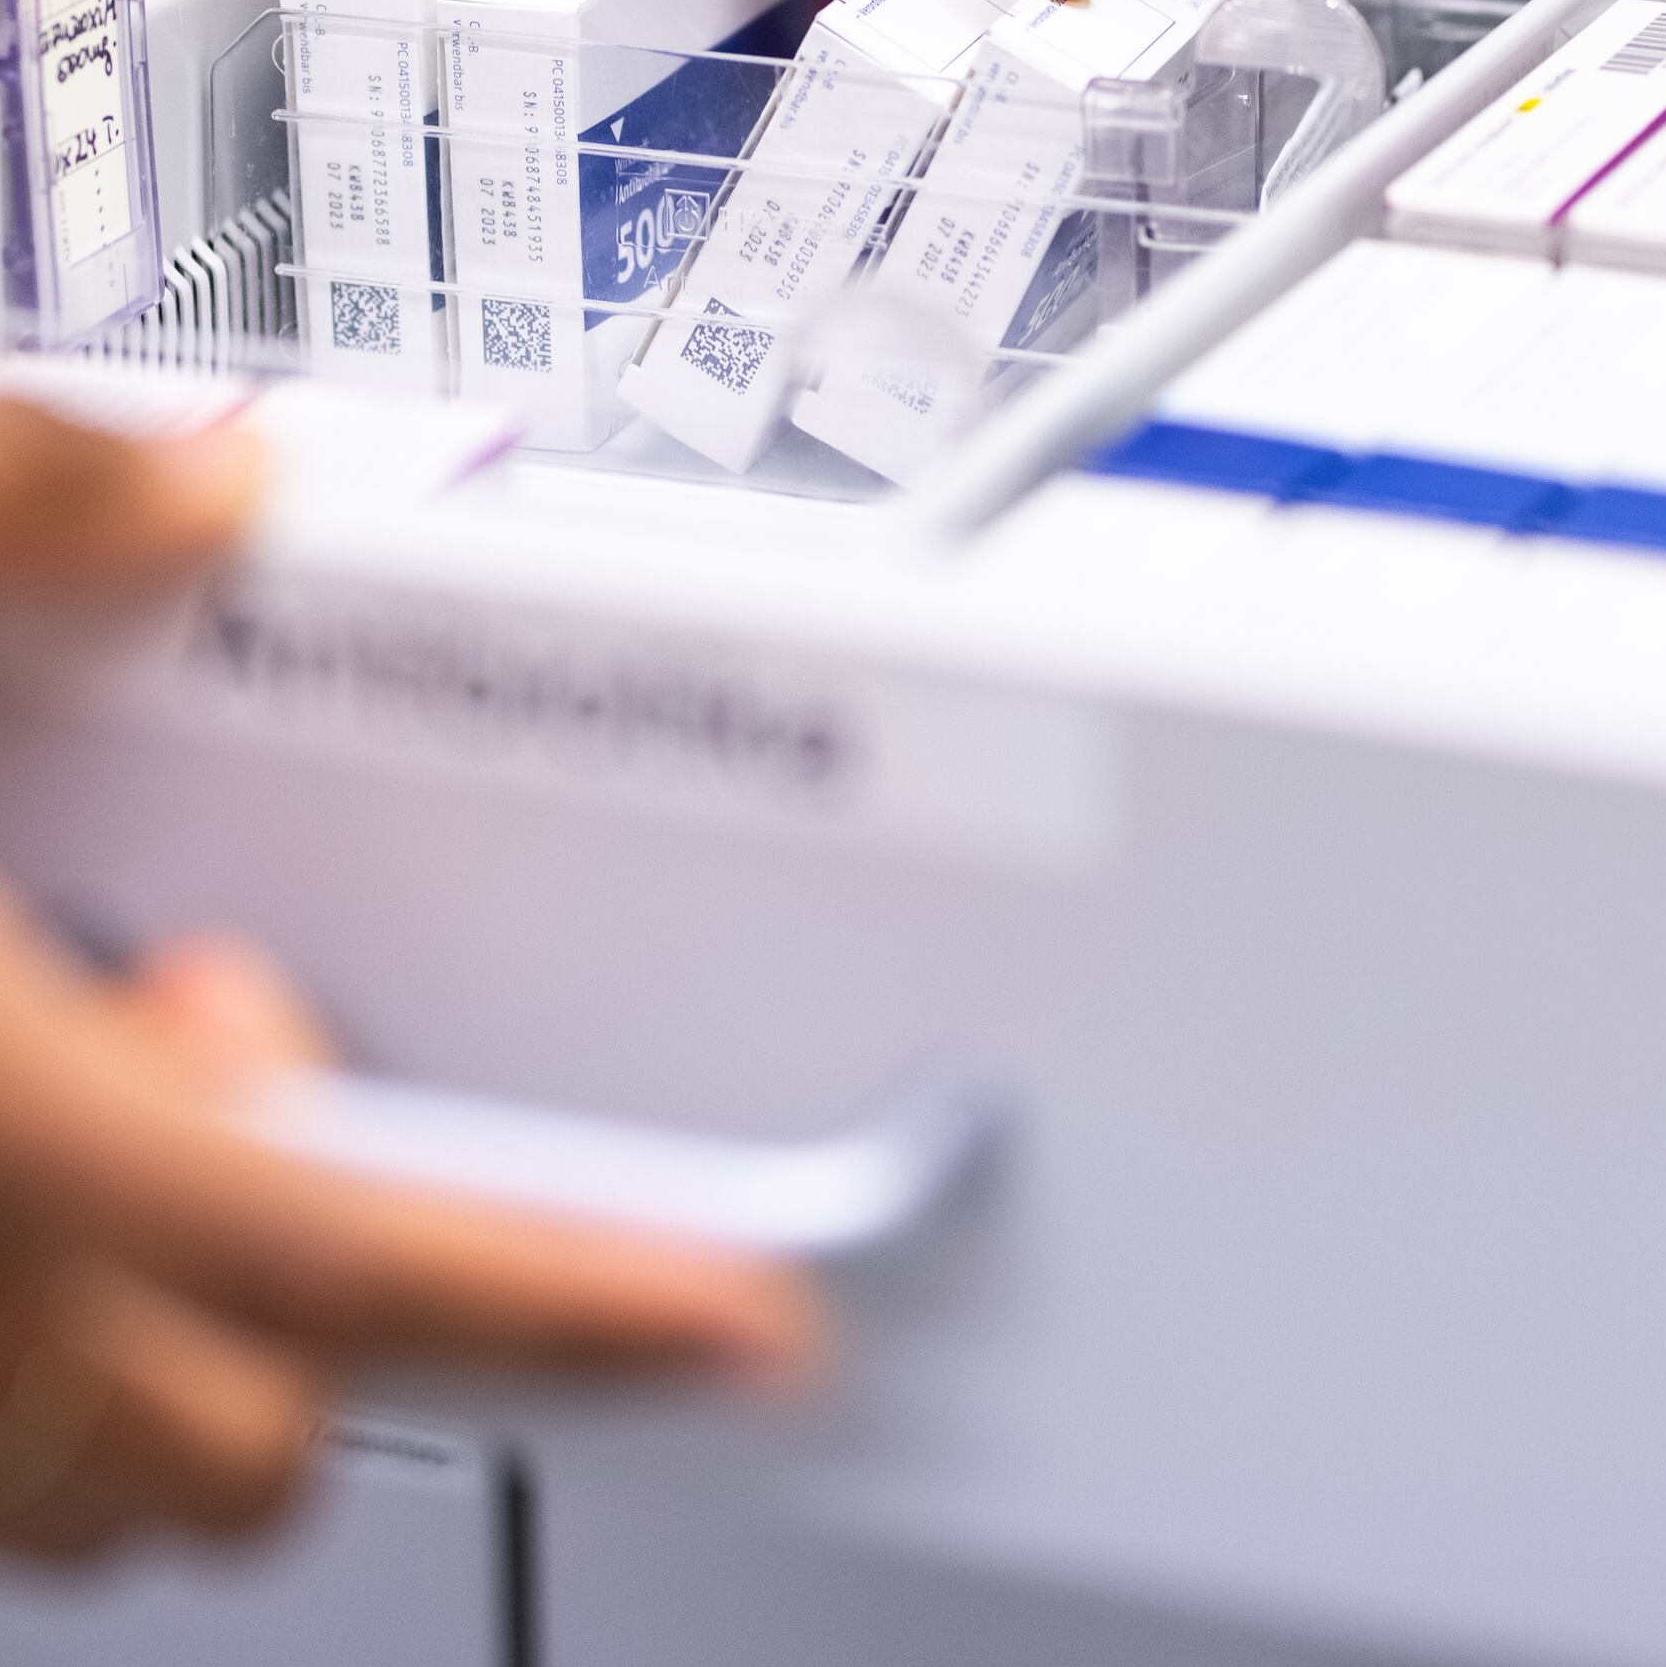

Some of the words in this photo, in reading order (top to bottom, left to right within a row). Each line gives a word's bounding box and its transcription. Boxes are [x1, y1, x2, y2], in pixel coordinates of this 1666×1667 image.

[397, 42, 408, 57] PC
[552, 60, 564, 74] PC
[302, 78, 313, 94] bis
[368, 75, 382, 102] SN:
[454, 95, 464, 111] bis
[523, 92, 537, 117] SN:
[327, 162, 341, 180] 07
[349, 165, 364, 221] KW8438
[481, 178, 493, 196] 07
[328, 192, 343, 230] 2023
[502, 180, 517, 238] KW8438
[482, 208, 495, 245] 2023
[935, 216, 956, 238] 07
